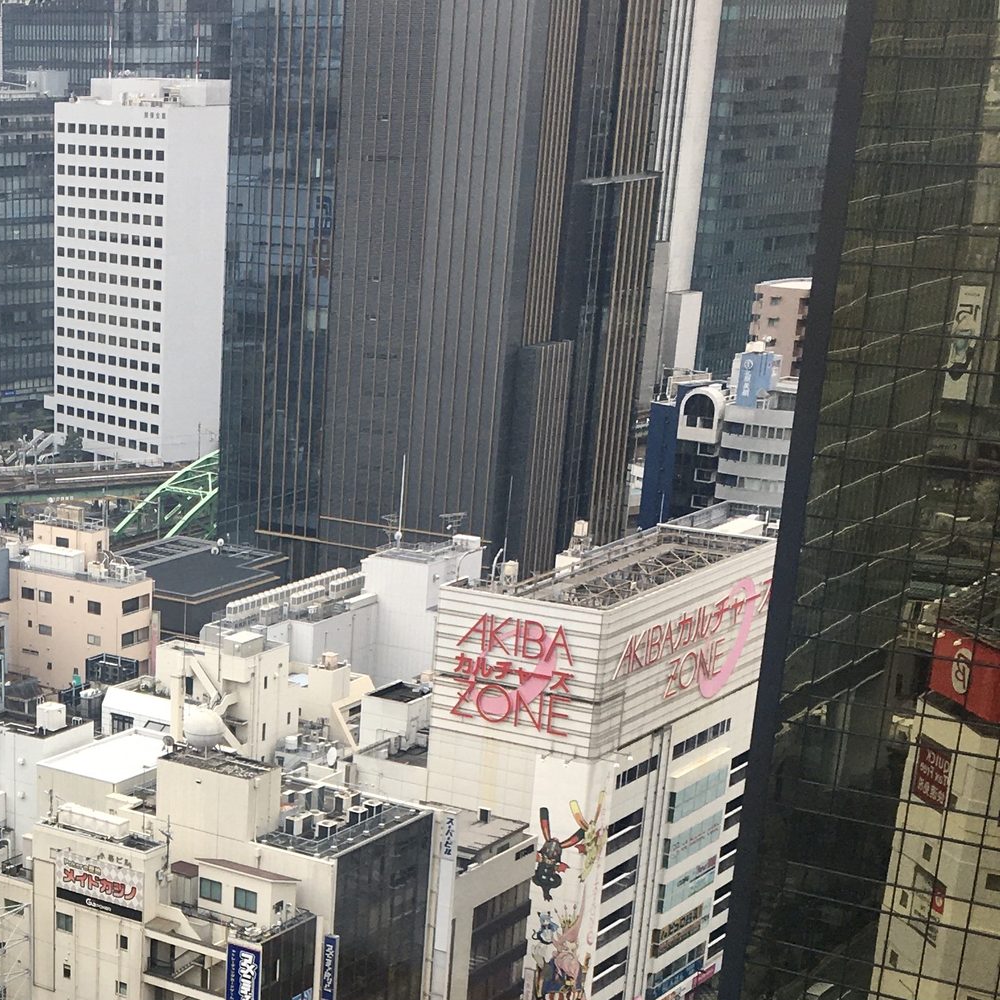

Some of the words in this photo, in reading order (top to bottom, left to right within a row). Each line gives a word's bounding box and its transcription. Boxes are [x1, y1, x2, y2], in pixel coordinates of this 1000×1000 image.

[457, 612, 574, 667] AKIBA
[454, 654, 575, 693] カルチャーズ
[663, 638, 727, 701] ZONE
[449, 676, 570, 737] ZONE
[62, 867, 137, 901] メイドカジノ
